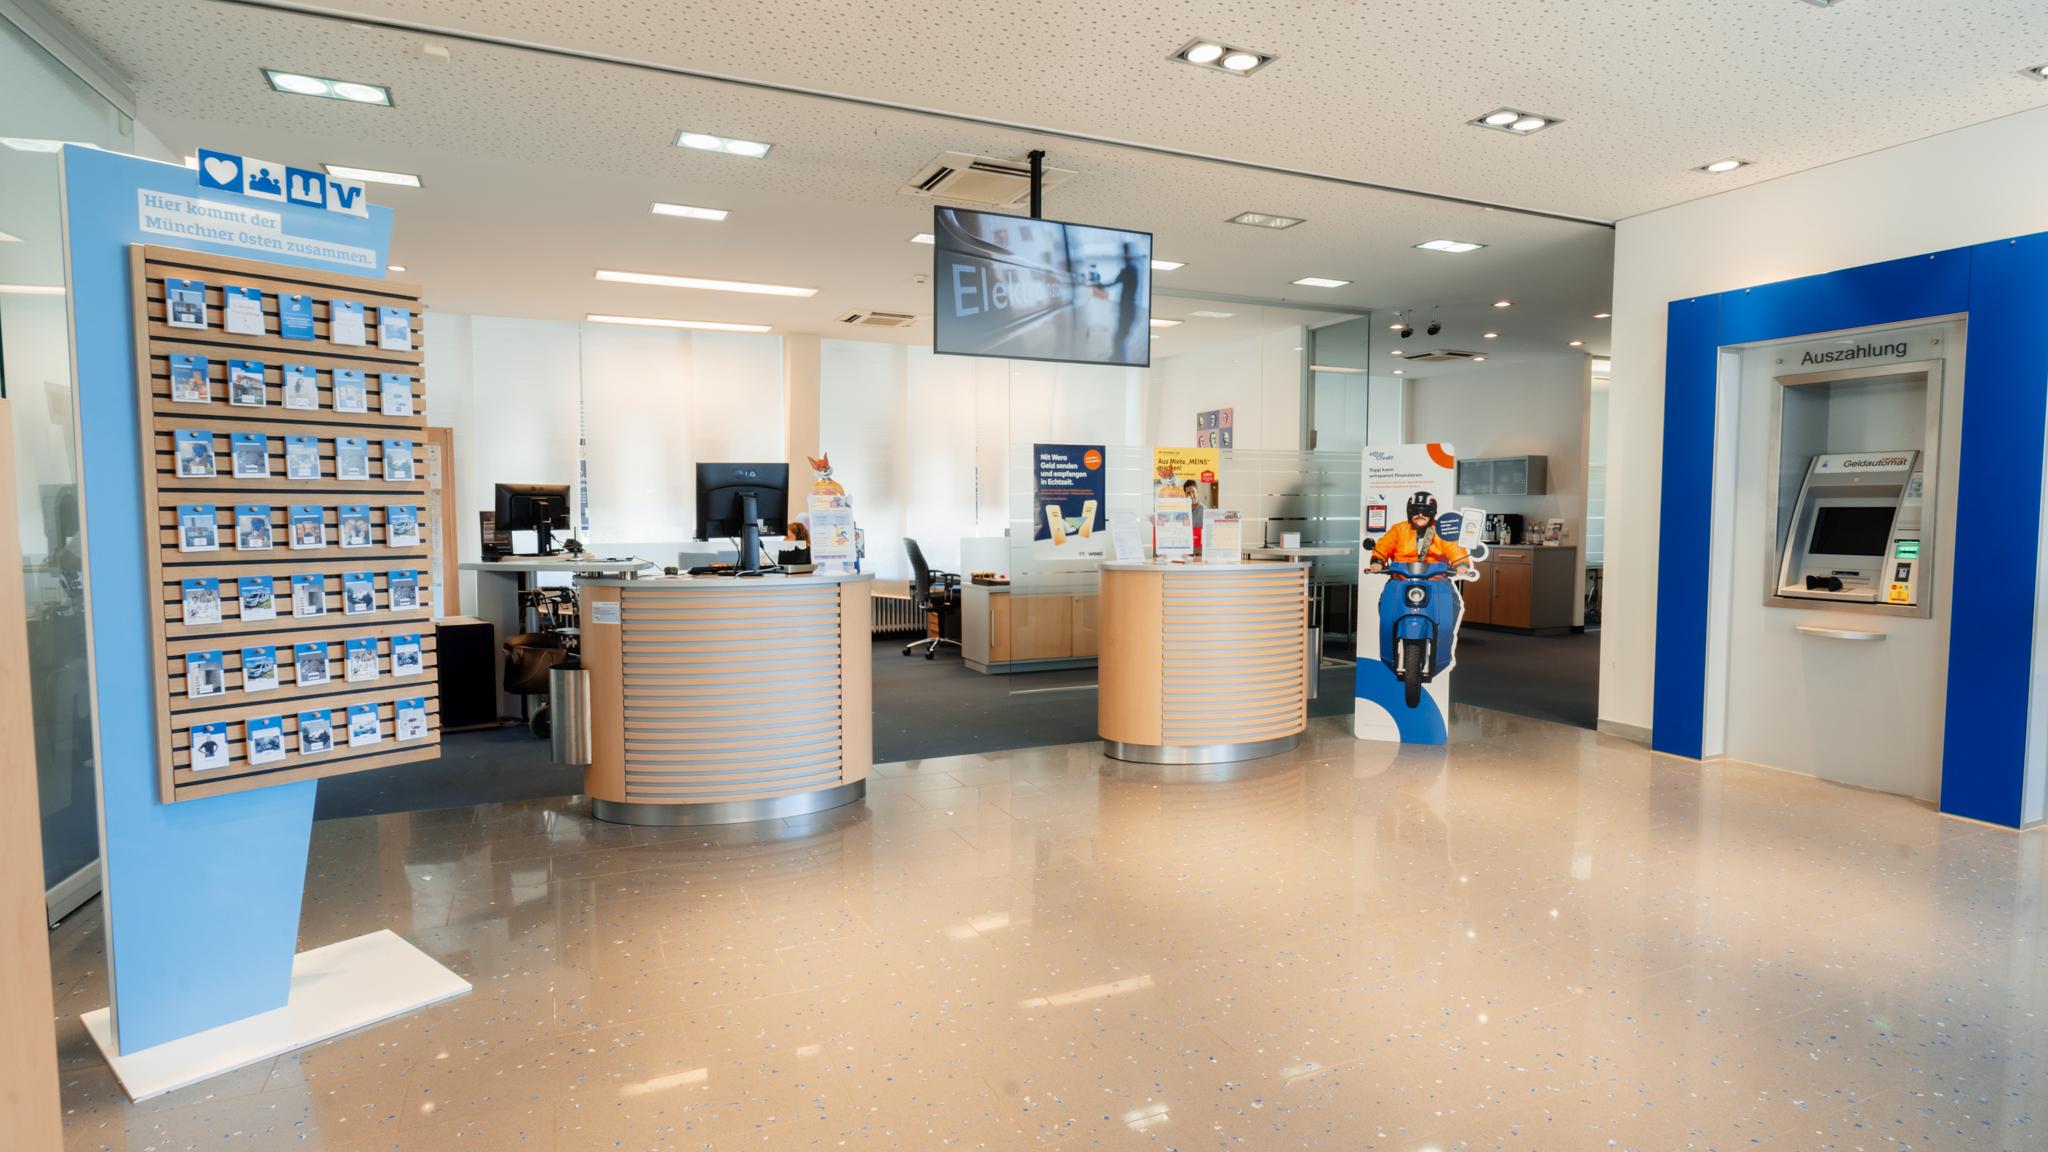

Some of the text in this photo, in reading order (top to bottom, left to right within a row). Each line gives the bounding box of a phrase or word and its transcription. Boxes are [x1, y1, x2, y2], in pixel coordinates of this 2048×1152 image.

[144, 193, 276, 229] Hier kommt der
[145, 215, 373, 265] Münchner Osten zusammen.
[1801, 342, 1908, 366] Auszahlung
[1041, 453, 1068, 461] Mit Wero
[1843, 458, 1908, 468] Geldautomat
[1054, 470, 1087, 479] empfangen
[1047, 478, 1074, 486] Echtzeit.
